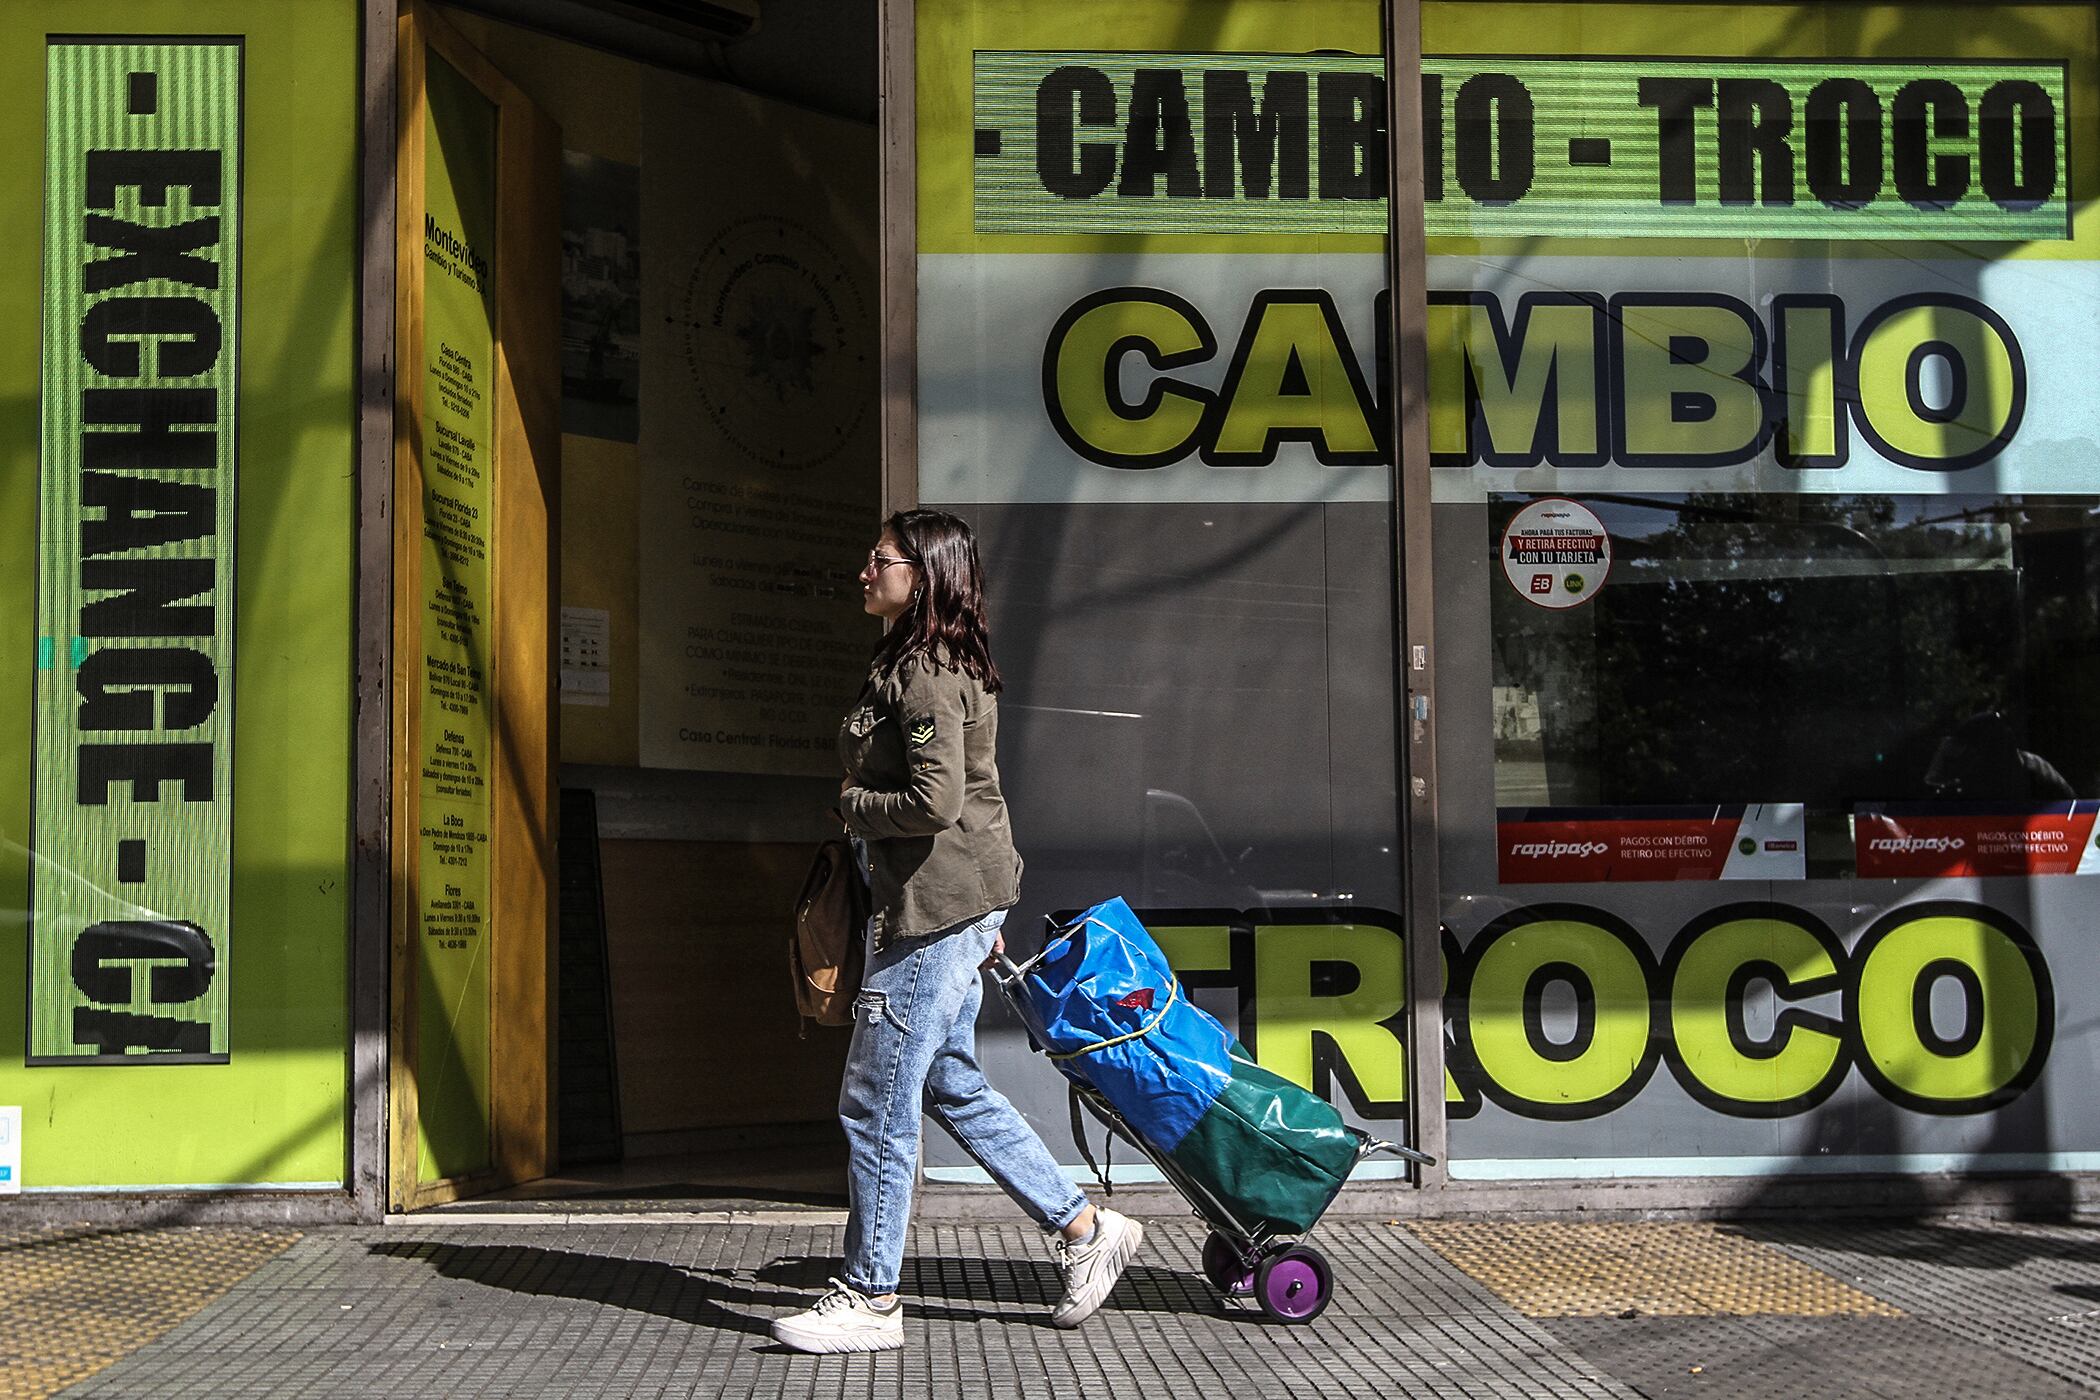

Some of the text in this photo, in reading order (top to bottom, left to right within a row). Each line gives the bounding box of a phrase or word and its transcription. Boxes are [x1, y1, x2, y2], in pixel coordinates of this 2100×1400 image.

[1036, 65, 1535, 207] CAMBIO
[1638, 77, 2057, 212] TROCO
[425, 212, 488, 280] Montevideo
[424, 243, 447, 270] Cambio
[452, 261, 476, 290] Turismo
[1042, 286, 2027, 472] CAMBIO
[77, 150, 221, 805] EXCHANGE
[1518, 539, 1524, 549] Y
[1557, 539, 1596, 549] EFECTIVO
[1520, 551, 1595, 563] CON TU TARJETA
[688, 626, 714, 642] PARA
[427, 654, 449, 671] Mercado
[457, 663, 466, 676] San
[444, 729, 465, 745] Defensa
[678, 727, 711, 745] Casa
[769, 733, 810, 749] Florida
[443, 813, 464, 828] La Boca
[1620, 834, 1708, 847] PAGOS CON DÉBITO
[1977, 829, 2064, 841] PAGOS CON DÉBITO
[1511, 840, 1608, 858] rapipago
[1870, 835, 1965, 854] rapipago
[1977, 843, 2068, 854] RETIRO DE EFECTIVO
[1621, 848, 1712, 859] RETIRO DE EFECTIVO
[445, 883, 462, 897] Flores
